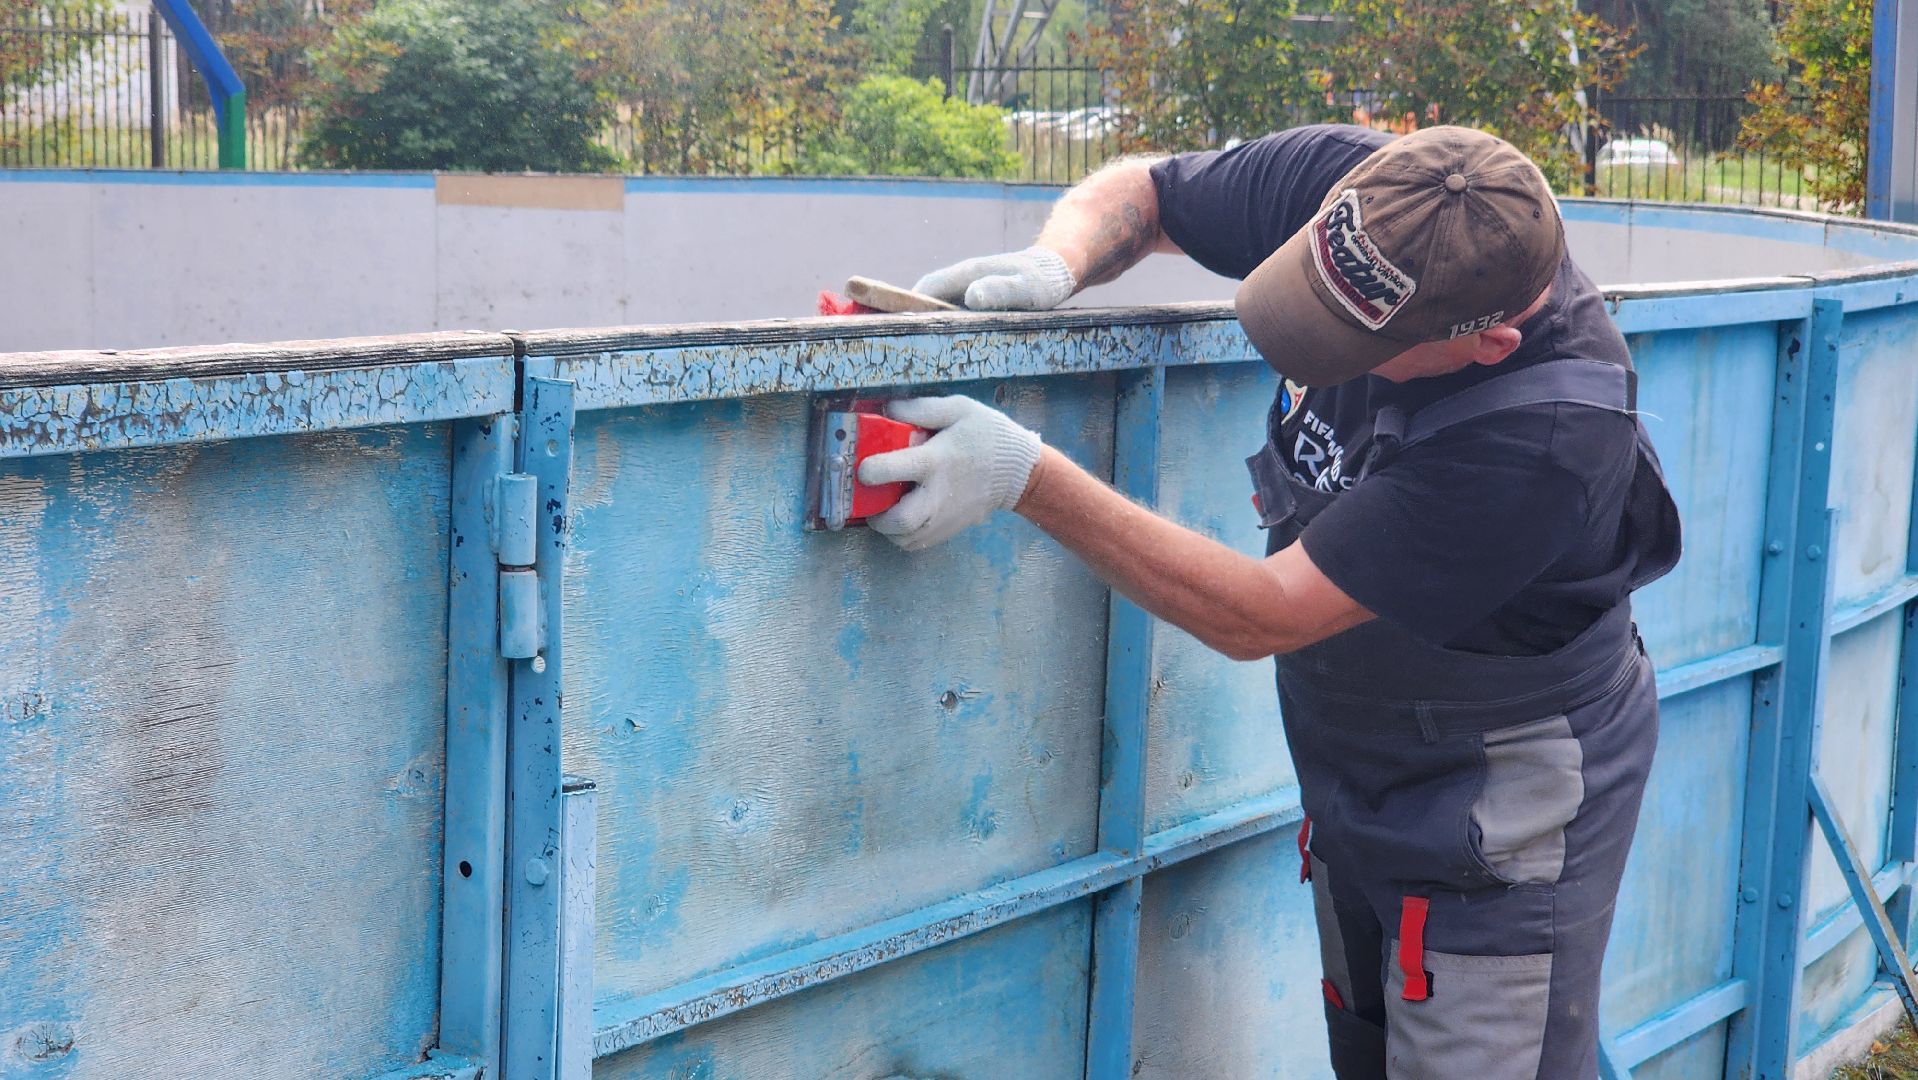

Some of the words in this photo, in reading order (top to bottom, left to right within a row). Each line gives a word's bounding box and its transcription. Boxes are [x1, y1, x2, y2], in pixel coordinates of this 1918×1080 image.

[1351, 234, 1378, 271] ORIGINAL
[1449, 310, 1505, 340] 1932
[1303, 409, 1335, 441] FIFA
